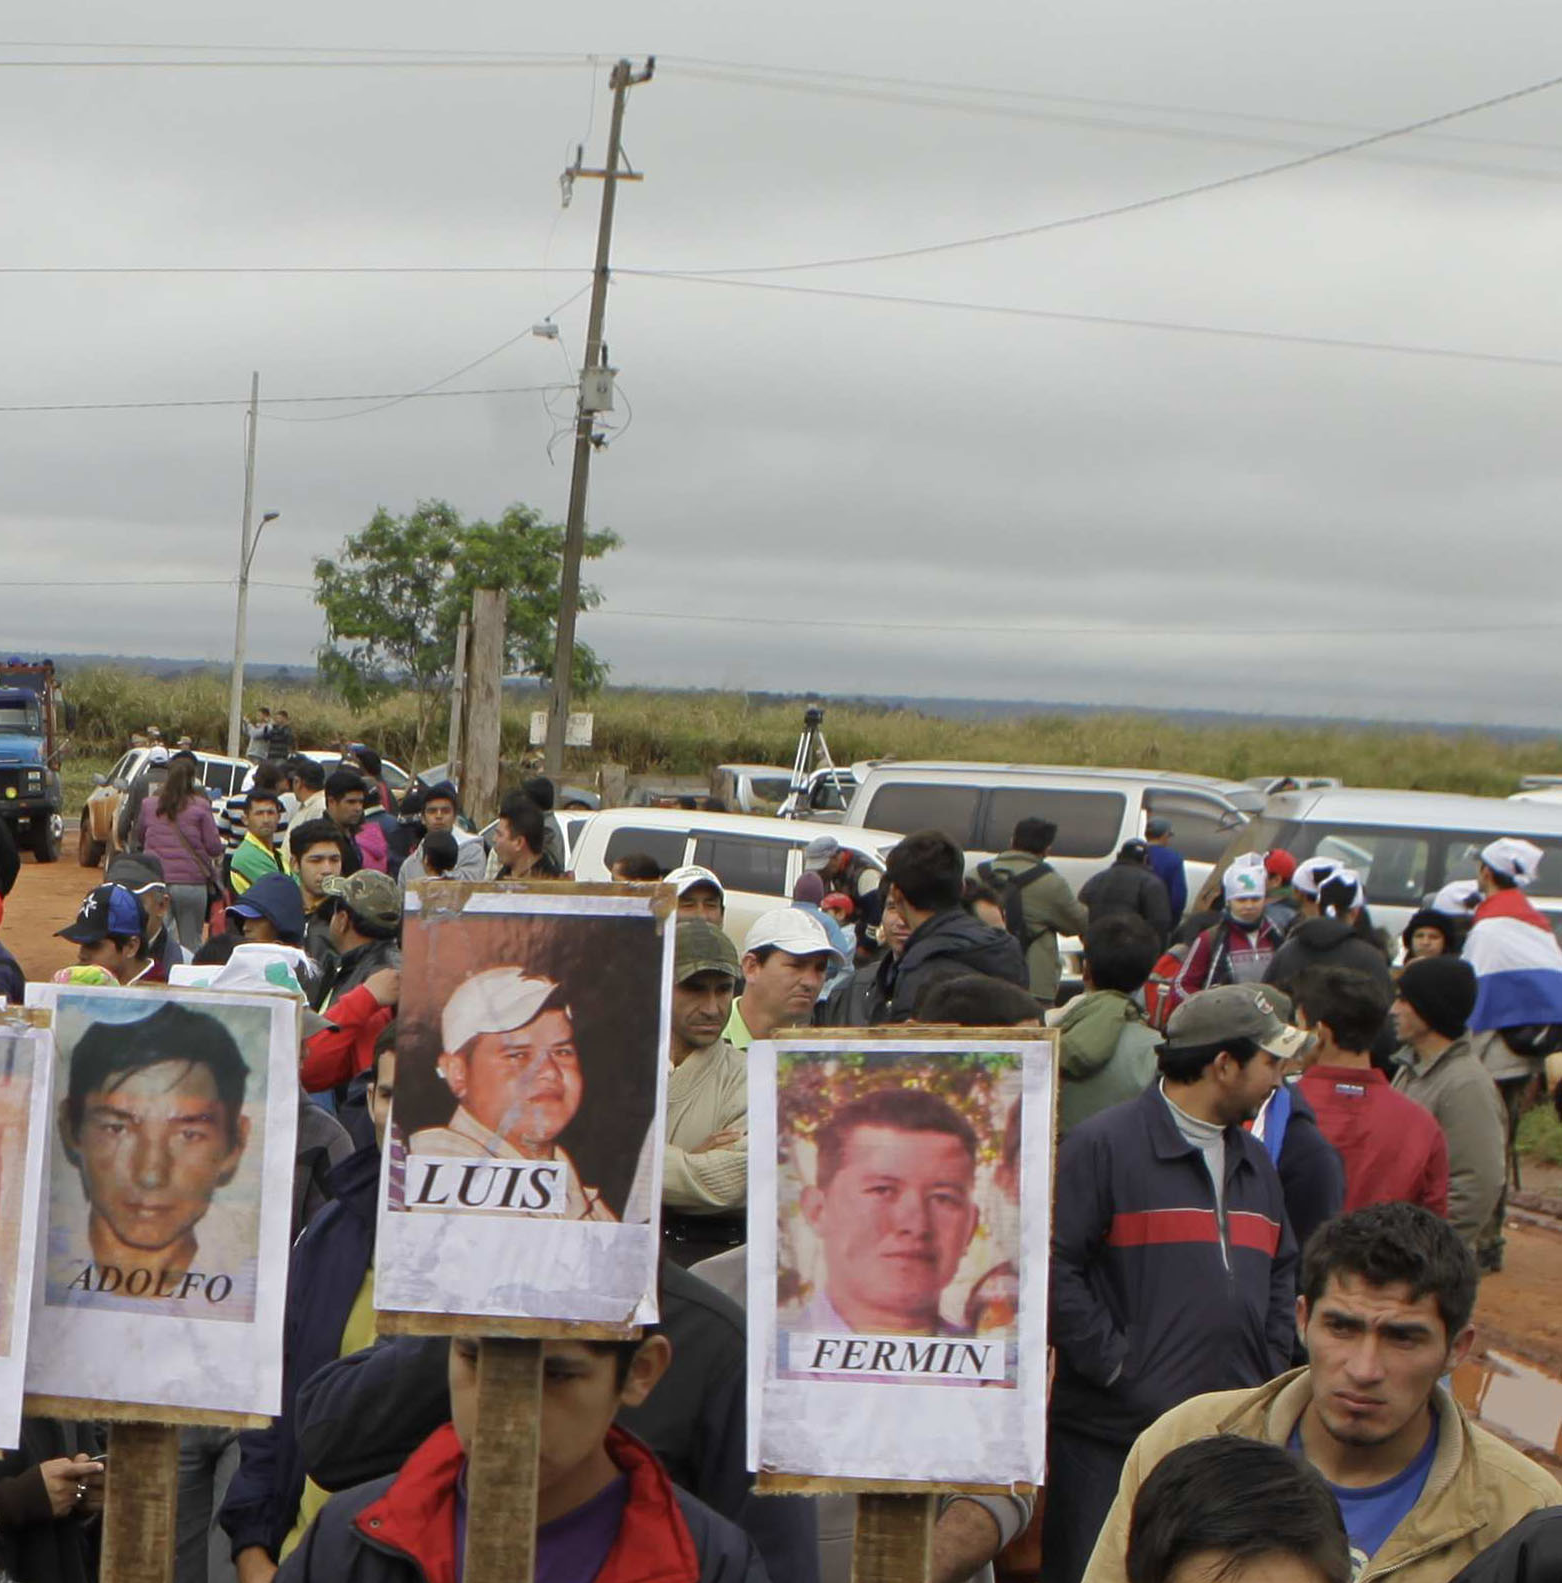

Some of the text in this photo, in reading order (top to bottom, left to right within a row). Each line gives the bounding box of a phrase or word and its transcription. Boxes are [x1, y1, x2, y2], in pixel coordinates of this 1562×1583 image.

[414, 1163, 562, 1210] LUIS
[67, 1265, 233, 1304] ADOLFO
[808, 1337, 994, 1375] FERMIN
